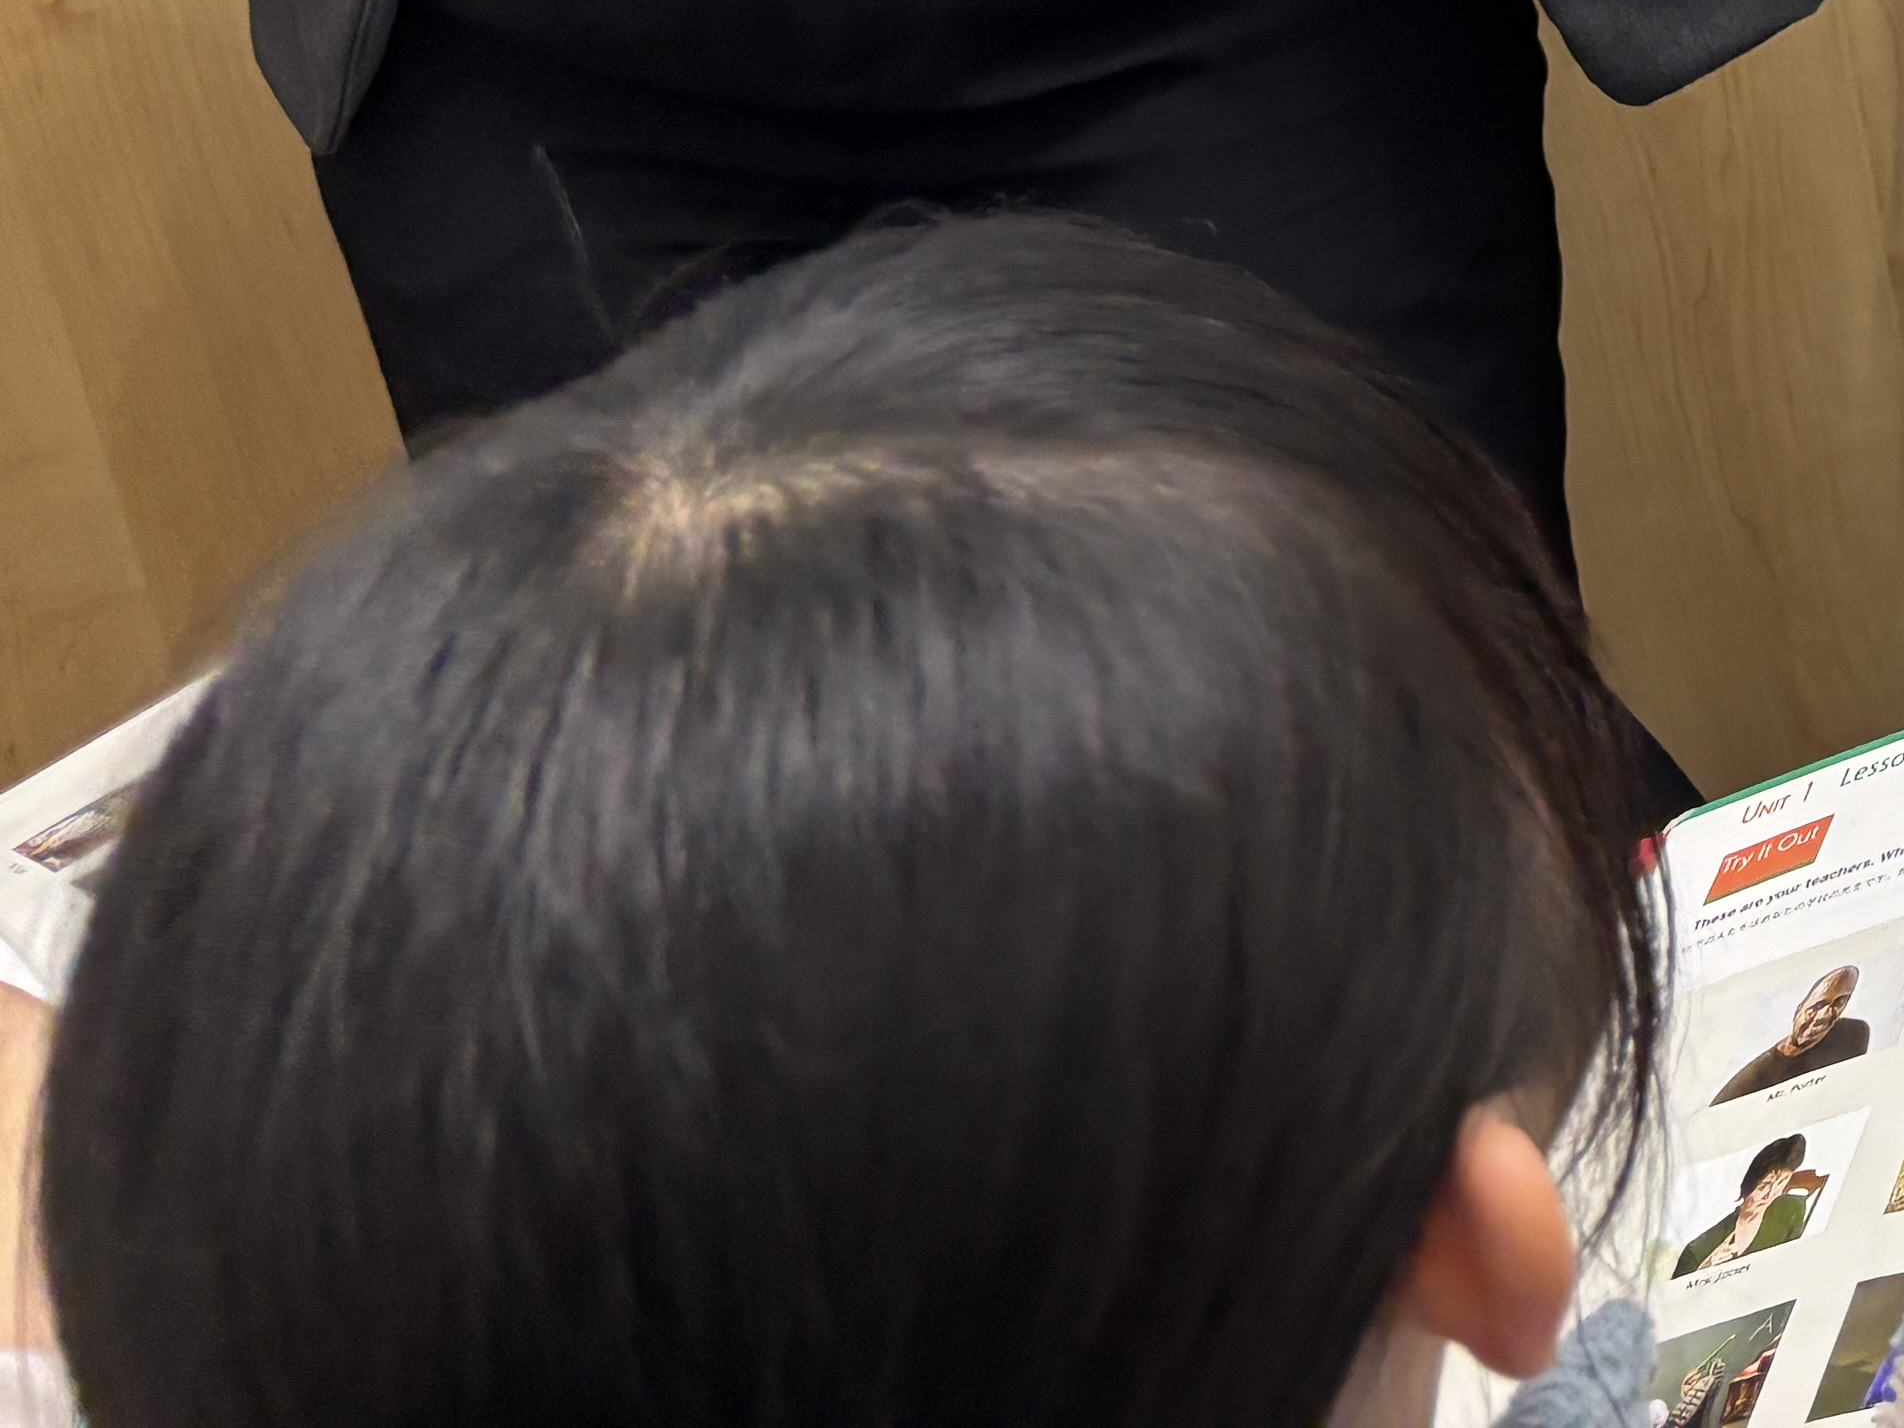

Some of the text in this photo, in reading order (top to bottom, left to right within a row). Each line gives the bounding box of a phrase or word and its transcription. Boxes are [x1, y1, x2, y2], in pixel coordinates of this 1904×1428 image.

[1803, 781, 1814, 802] 1
[1722, 824, 1821, 874] Try It Out
[1693, 908, 1737, 932] These
[1739, 897, 1765, 915] are
[1765, 884, 1802, 907] your
[1805, 859, 1875, 890] teachers.
